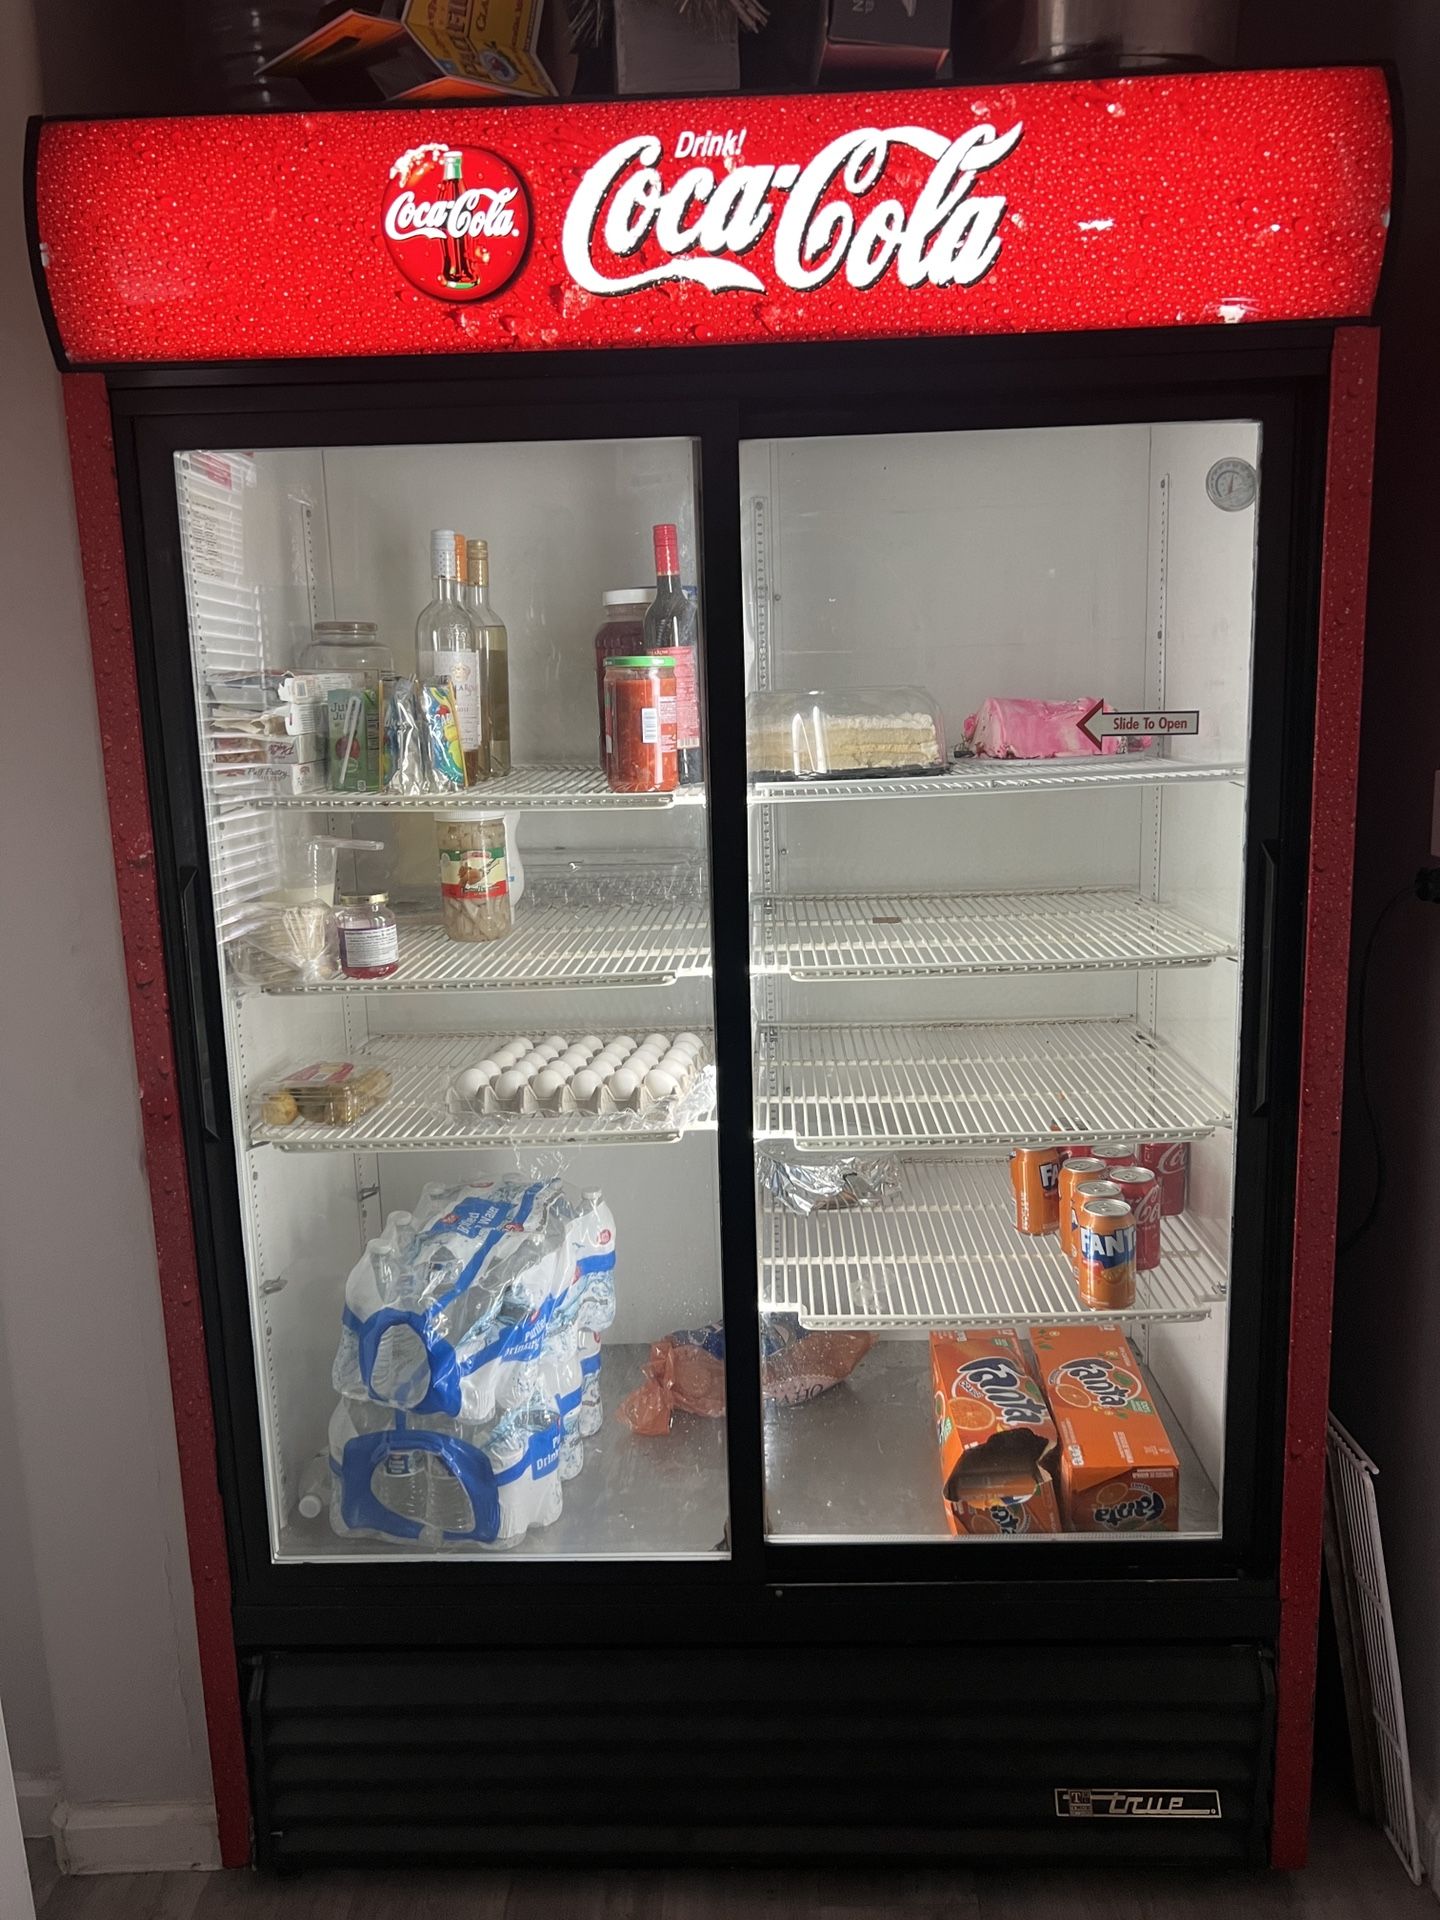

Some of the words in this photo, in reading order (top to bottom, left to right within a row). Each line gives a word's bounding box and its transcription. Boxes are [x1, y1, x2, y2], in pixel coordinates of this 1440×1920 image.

[674, 129, 747, 158] Drink!
[385, 186, 520, 241] Coca-Cola
[562, 120, 1023, 297] Coca-Cola
[1113, 717, 1139, 730] Slide
[1143, 717, 1155, 729] To
[1158, 717, 1187, 732] Open
[1080, 1226, 1136, 1257] FANT
[957, 1356, 1050, 1425] Fanta
[1058, 1357, 1130, 1408] Fanta
[1093, 1491, 1165, 1526] Fanta
